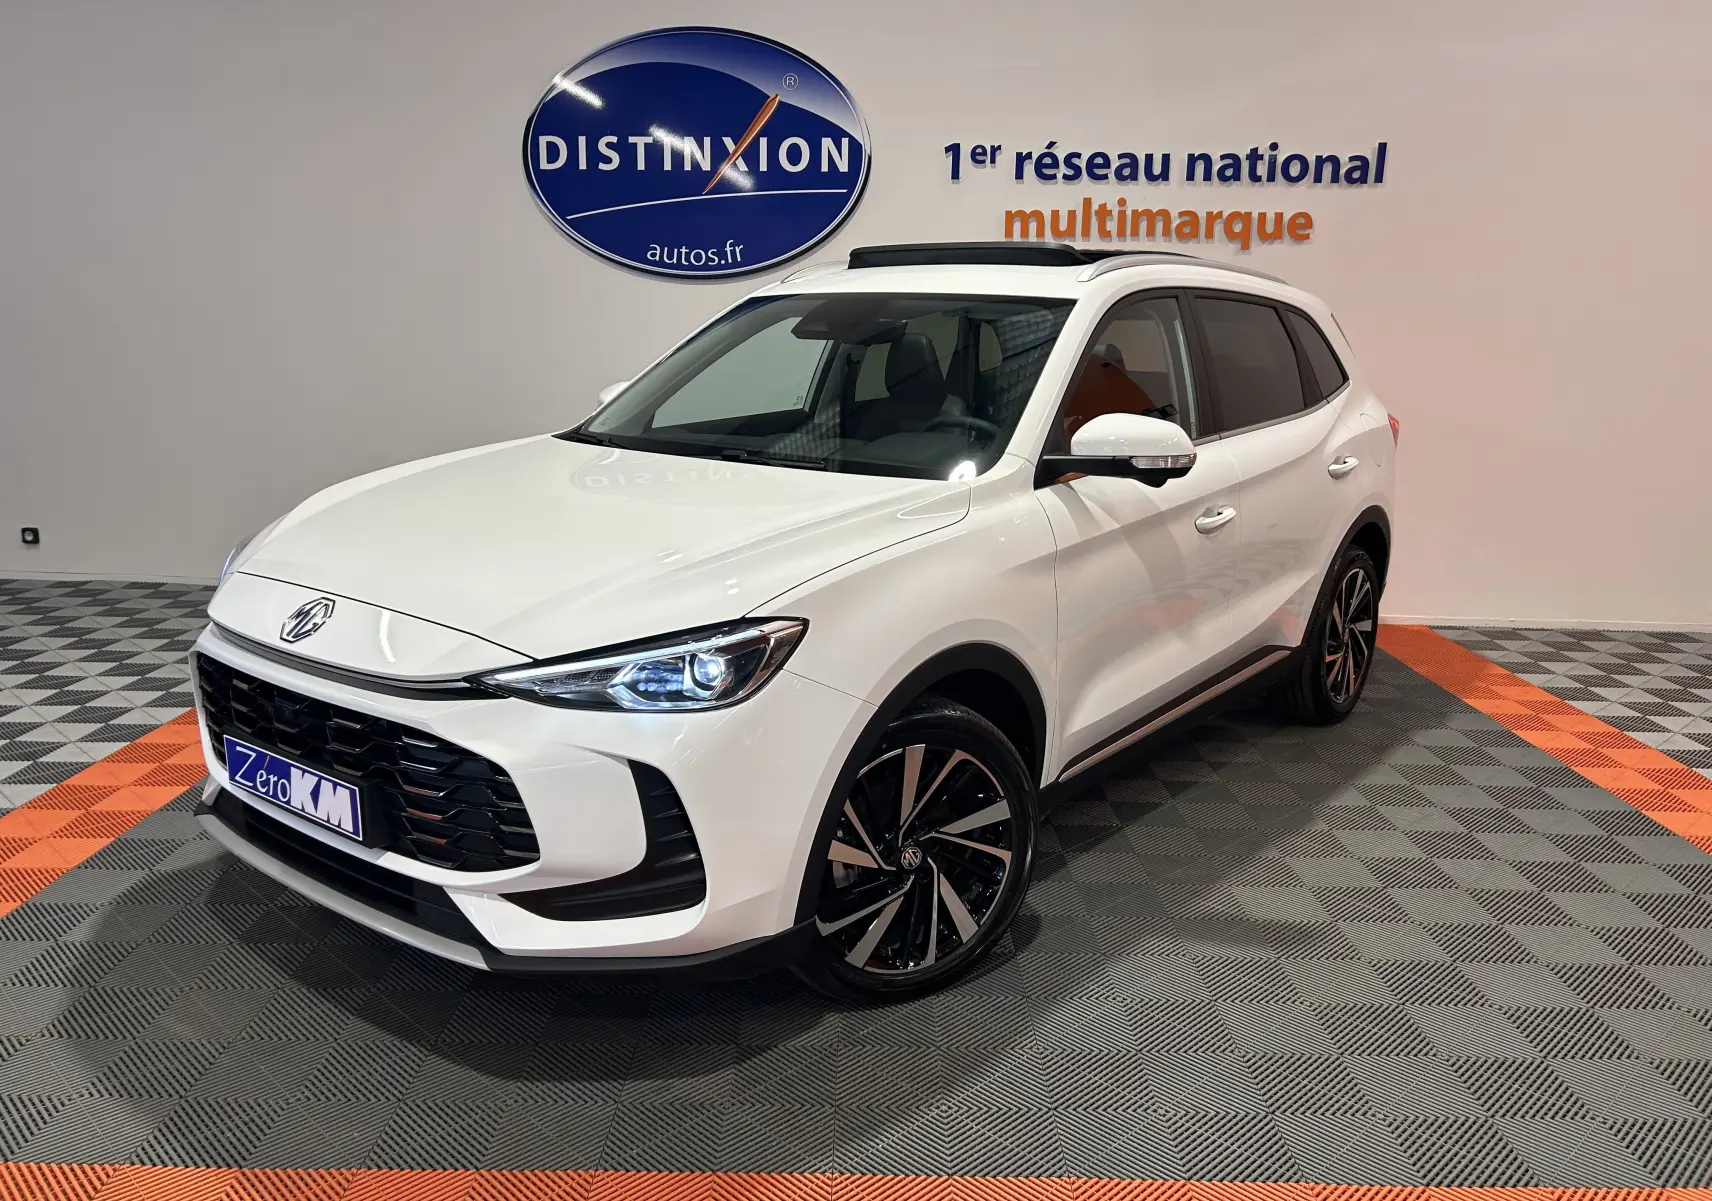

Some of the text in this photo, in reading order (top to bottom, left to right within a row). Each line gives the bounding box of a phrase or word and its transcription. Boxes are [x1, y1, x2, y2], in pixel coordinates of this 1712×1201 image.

[538, 134, 849, 174] DISTINXION
[944, 140, 1388, 184] 1er réseau national
[1004, 196, 1314, 250] multimarque
[646, 240, 744, 266] autos.fr
[283, 600, 333, 641] MG
[903, 849, 920, 867] MG
